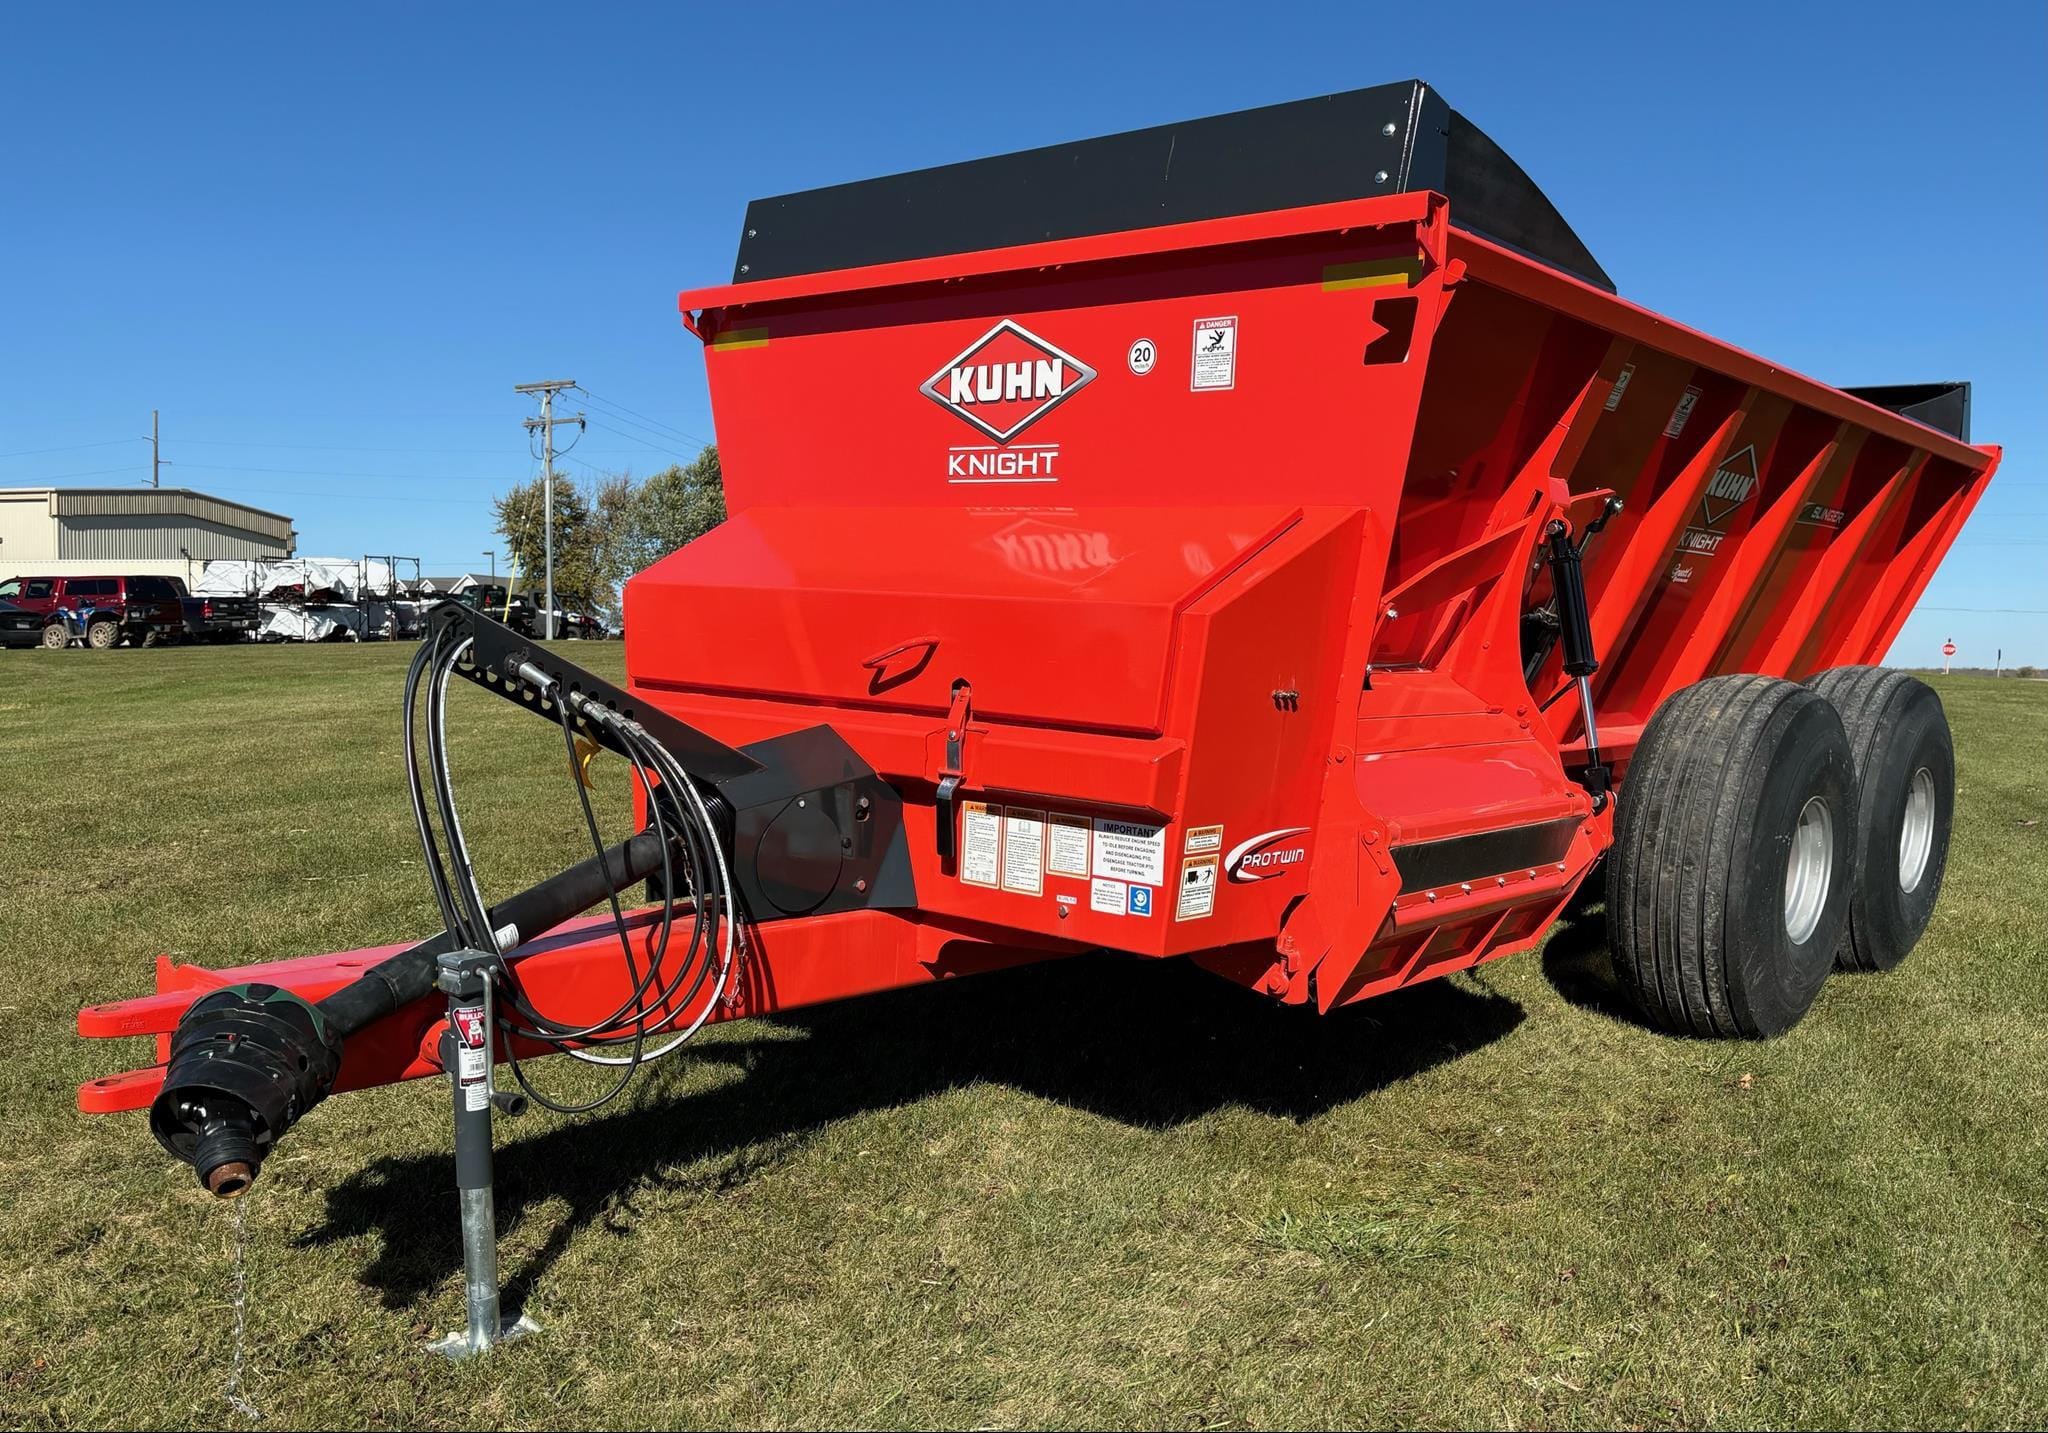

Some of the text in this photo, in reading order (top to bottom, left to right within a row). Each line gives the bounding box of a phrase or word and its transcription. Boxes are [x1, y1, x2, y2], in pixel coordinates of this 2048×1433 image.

[1206, 320, 1232, 329] DANGER
[1134, 347, 1151, 363] 20
[949, 358, 1063, 405] KUHN
[948, 452, 1060, 477] KNIGHT
[1706, 469, 1755, 503] KUHN
[1810, 506, 1846, 524] SLINGER
[1679, 531, 1724, 551] KNIGHT
[1103, 823, 1156, 838] IMPORTANT
[1114, 835, 1131, 843] REDUCE
[1114, 851, 1142, 860] DISENGAGING
[1134, 846, 1156, 854] ENGAGING
[1102, 857, 1126, 865] DISENGAGE
[1126, 860, 1145, 868] TRACTOR
[1241, 849, 1304, 868] PROTWIN
